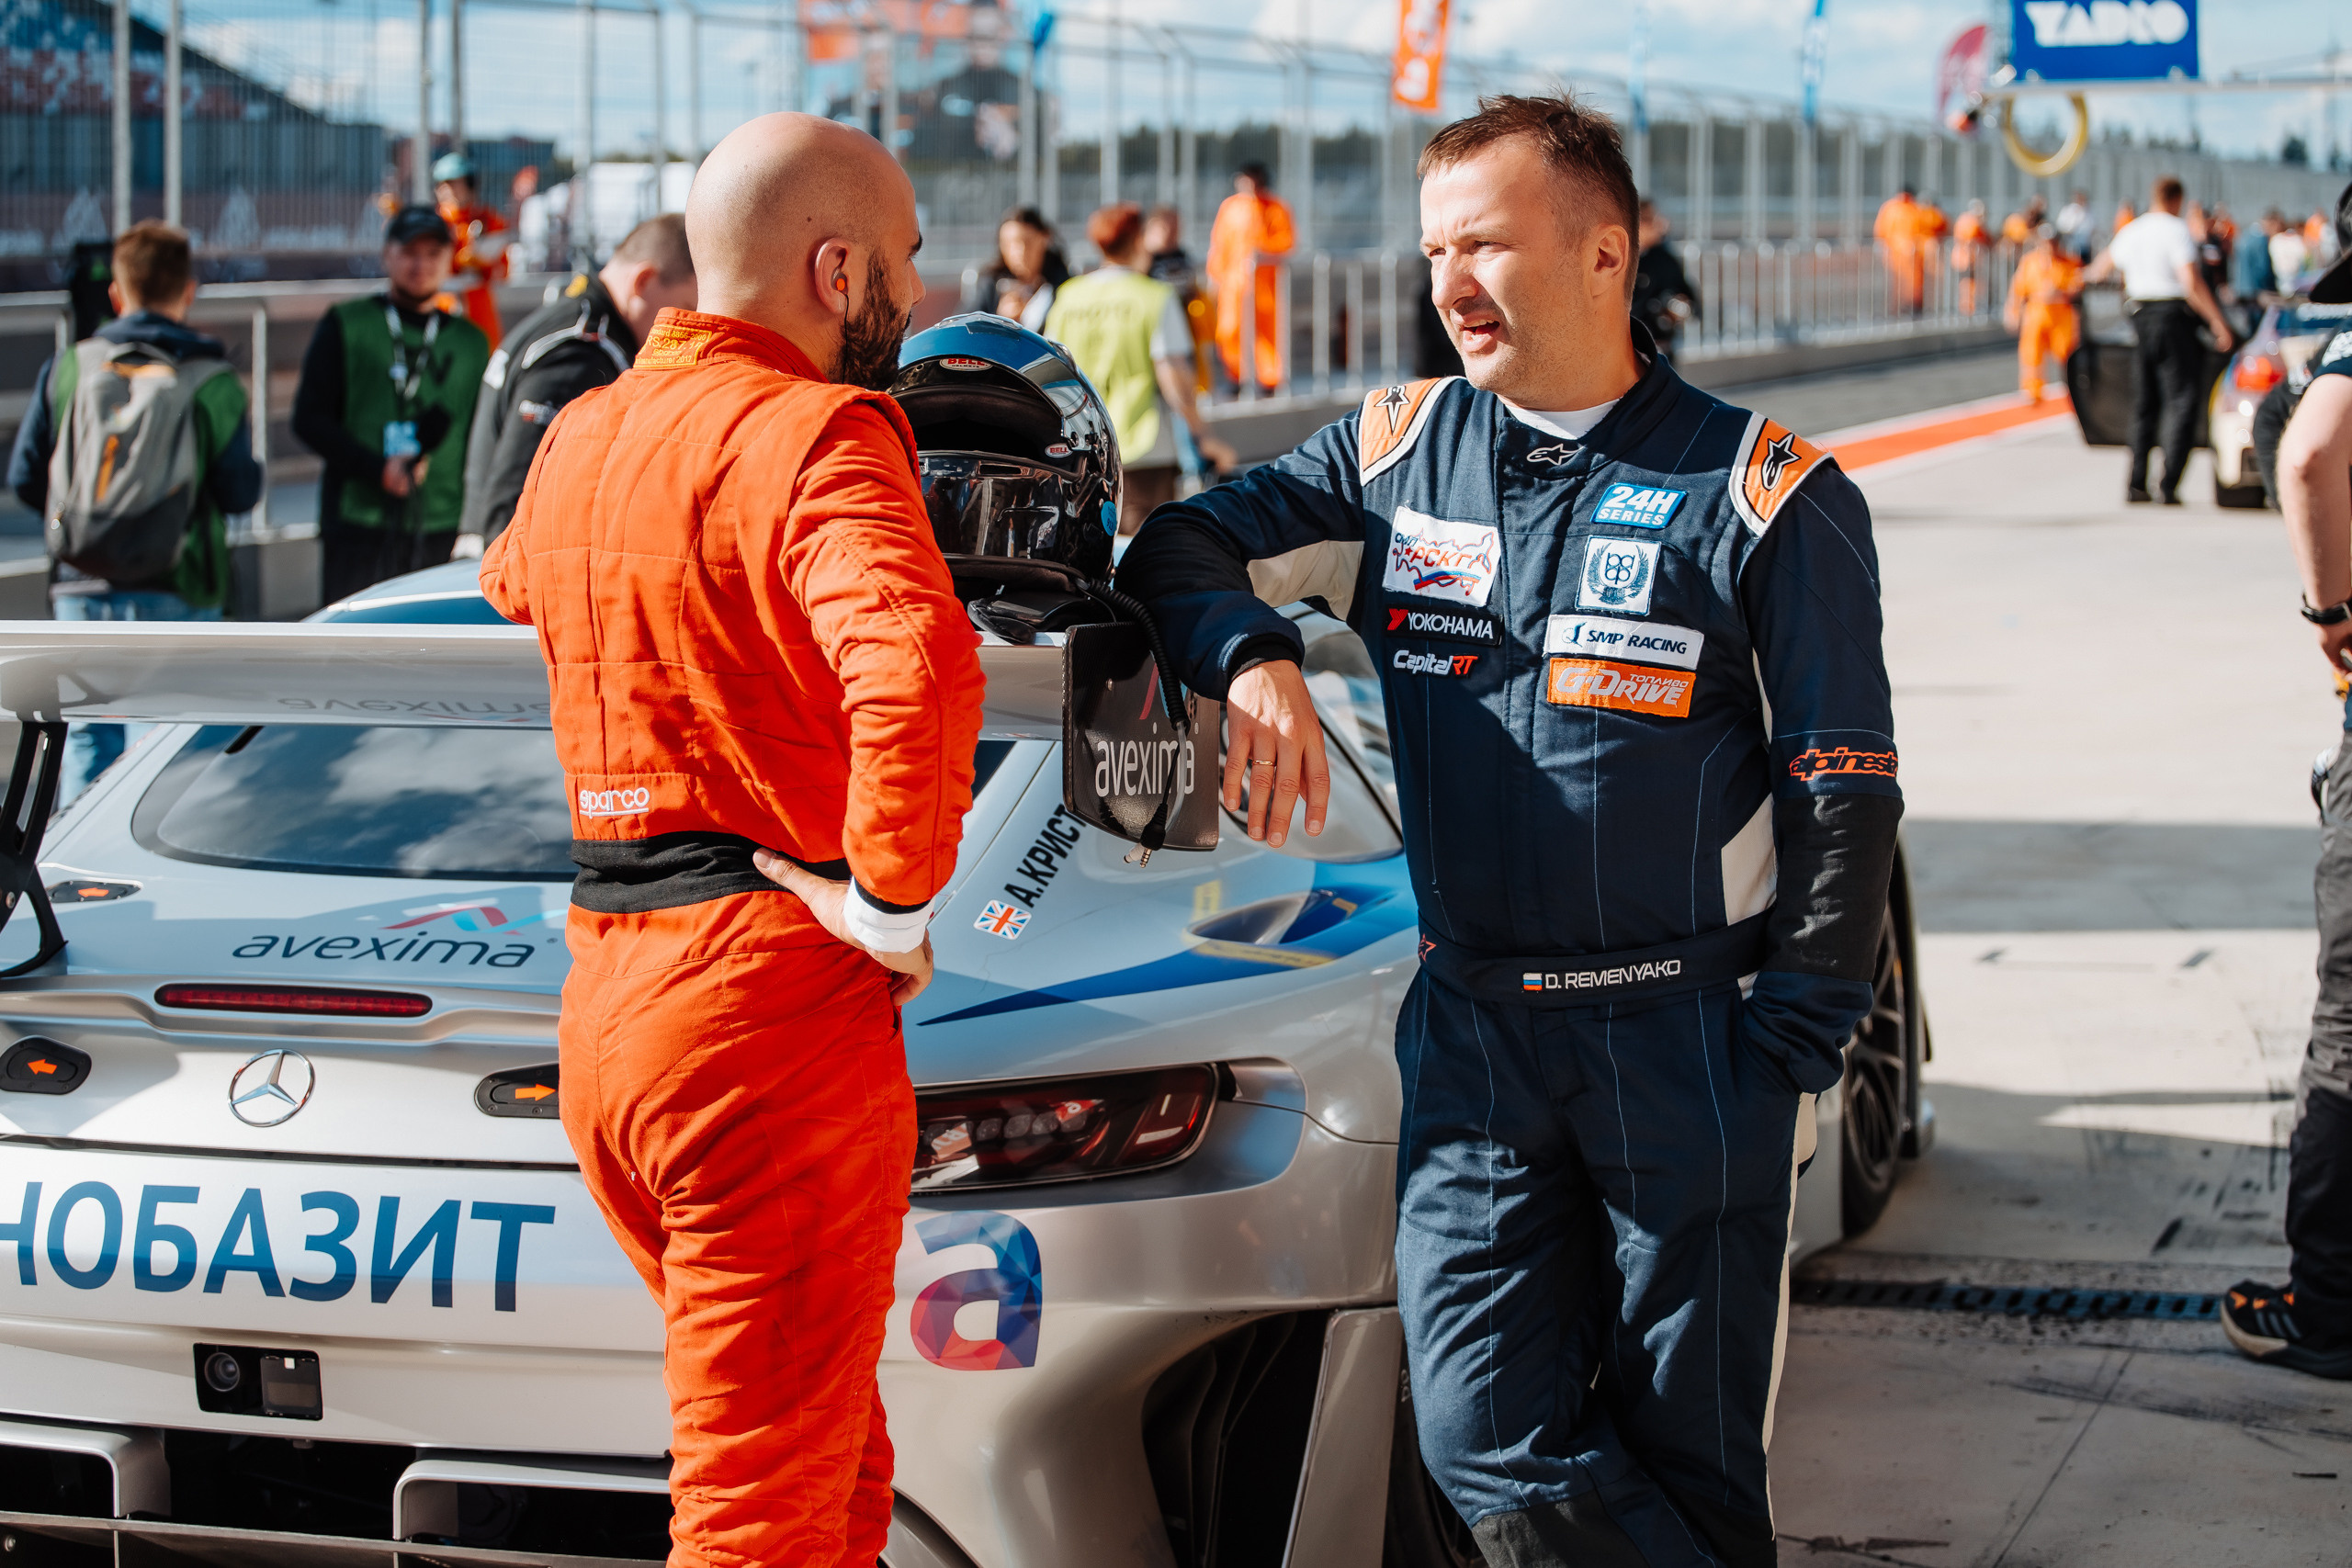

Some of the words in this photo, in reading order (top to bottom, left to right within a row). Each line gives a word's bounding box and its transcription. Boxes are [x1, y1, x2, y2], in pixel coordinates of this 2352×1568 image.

[948, 357, 986, 367] BELL
[1604, 486, 1679, 514] 24H
[1598, 508, 1665, 526] SERIES
[1408, 612, 1494, 639] YOKOHAMA
[1587, 630, 1624, 645] SMP
[1627, 635, 1688, 655] RACING
[580, 787, 650, 819] sparco
[232, 931, 536, 968] avexima
[1545, 974, 1562, 989] D.
[1565, 959, 1681, 989] REMENYAKO
